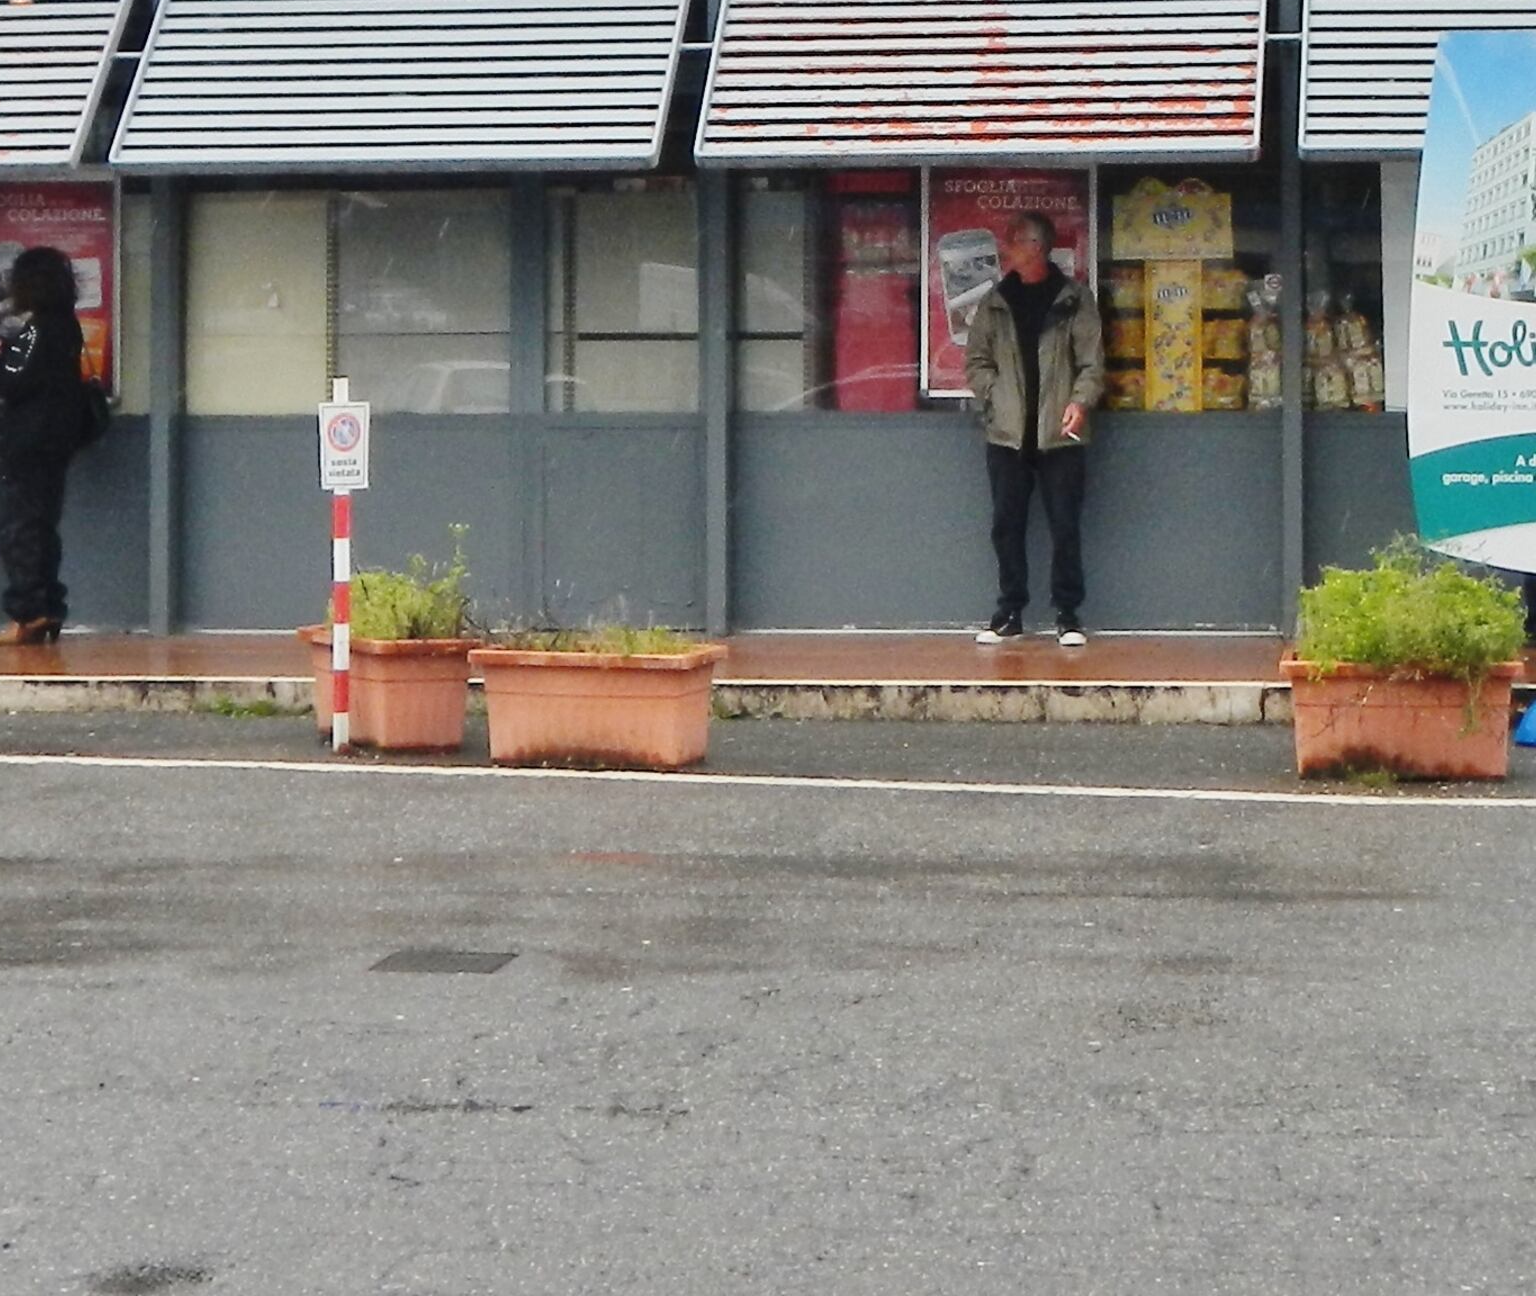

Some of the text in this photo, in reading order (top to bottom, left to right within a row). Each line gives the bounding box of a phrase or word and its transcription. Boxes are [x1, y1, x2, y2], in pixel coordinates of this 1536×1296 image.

[1515, 454, 1526, 467] A
[1442, 473, 1489, 486] garage,
[1492, 470, 1534, 485] piscina
